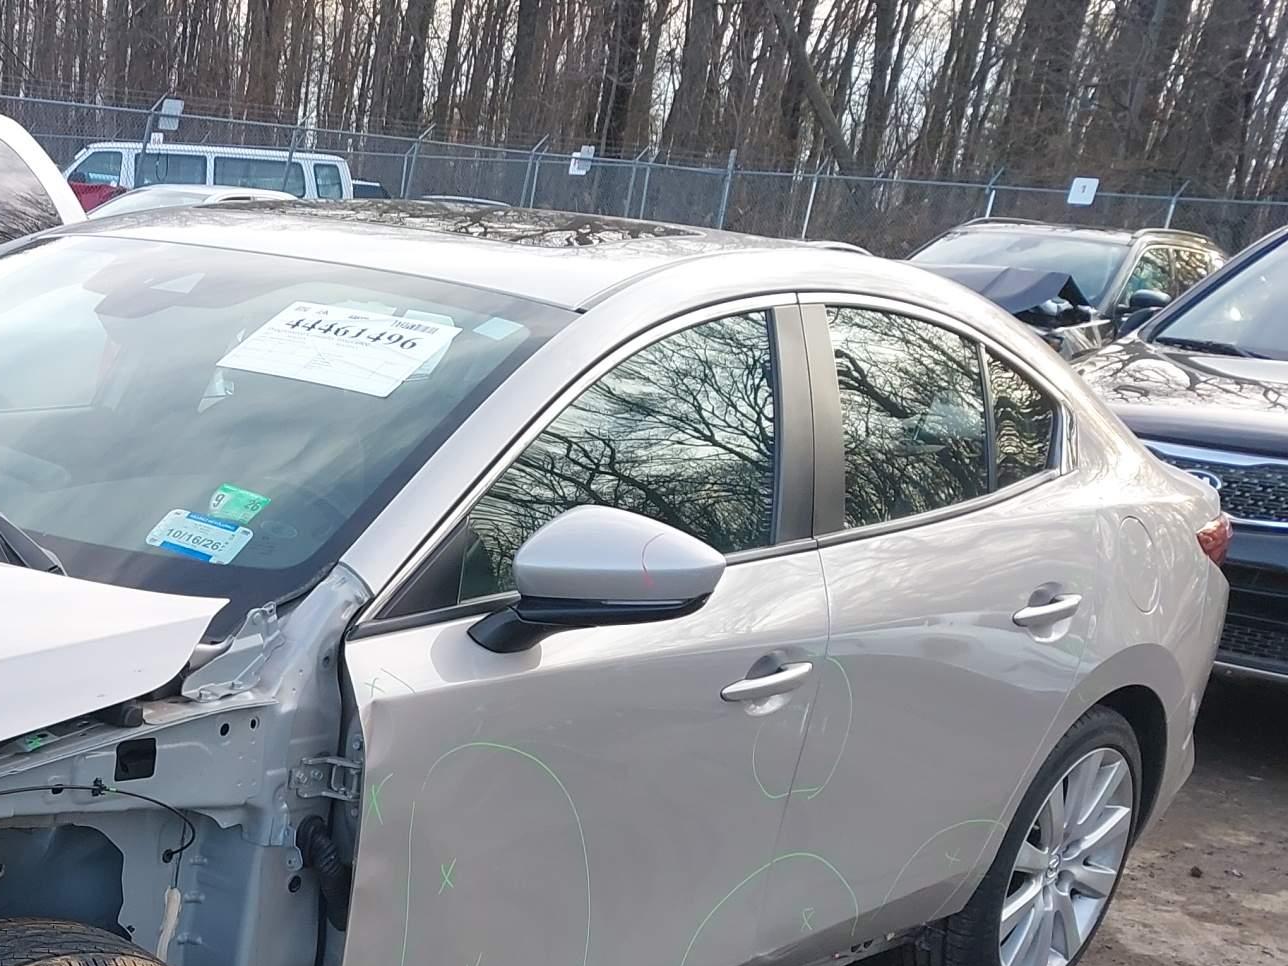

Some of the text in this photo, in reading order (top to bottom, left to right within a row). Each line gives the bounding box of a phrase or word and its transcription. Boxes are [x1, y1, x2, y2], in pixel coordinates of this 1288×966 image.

[286, 318, 424, 350] 44461496
[213, 494, 260, 511] 9 26
[167, 527, 221, 551] 10/16/26
